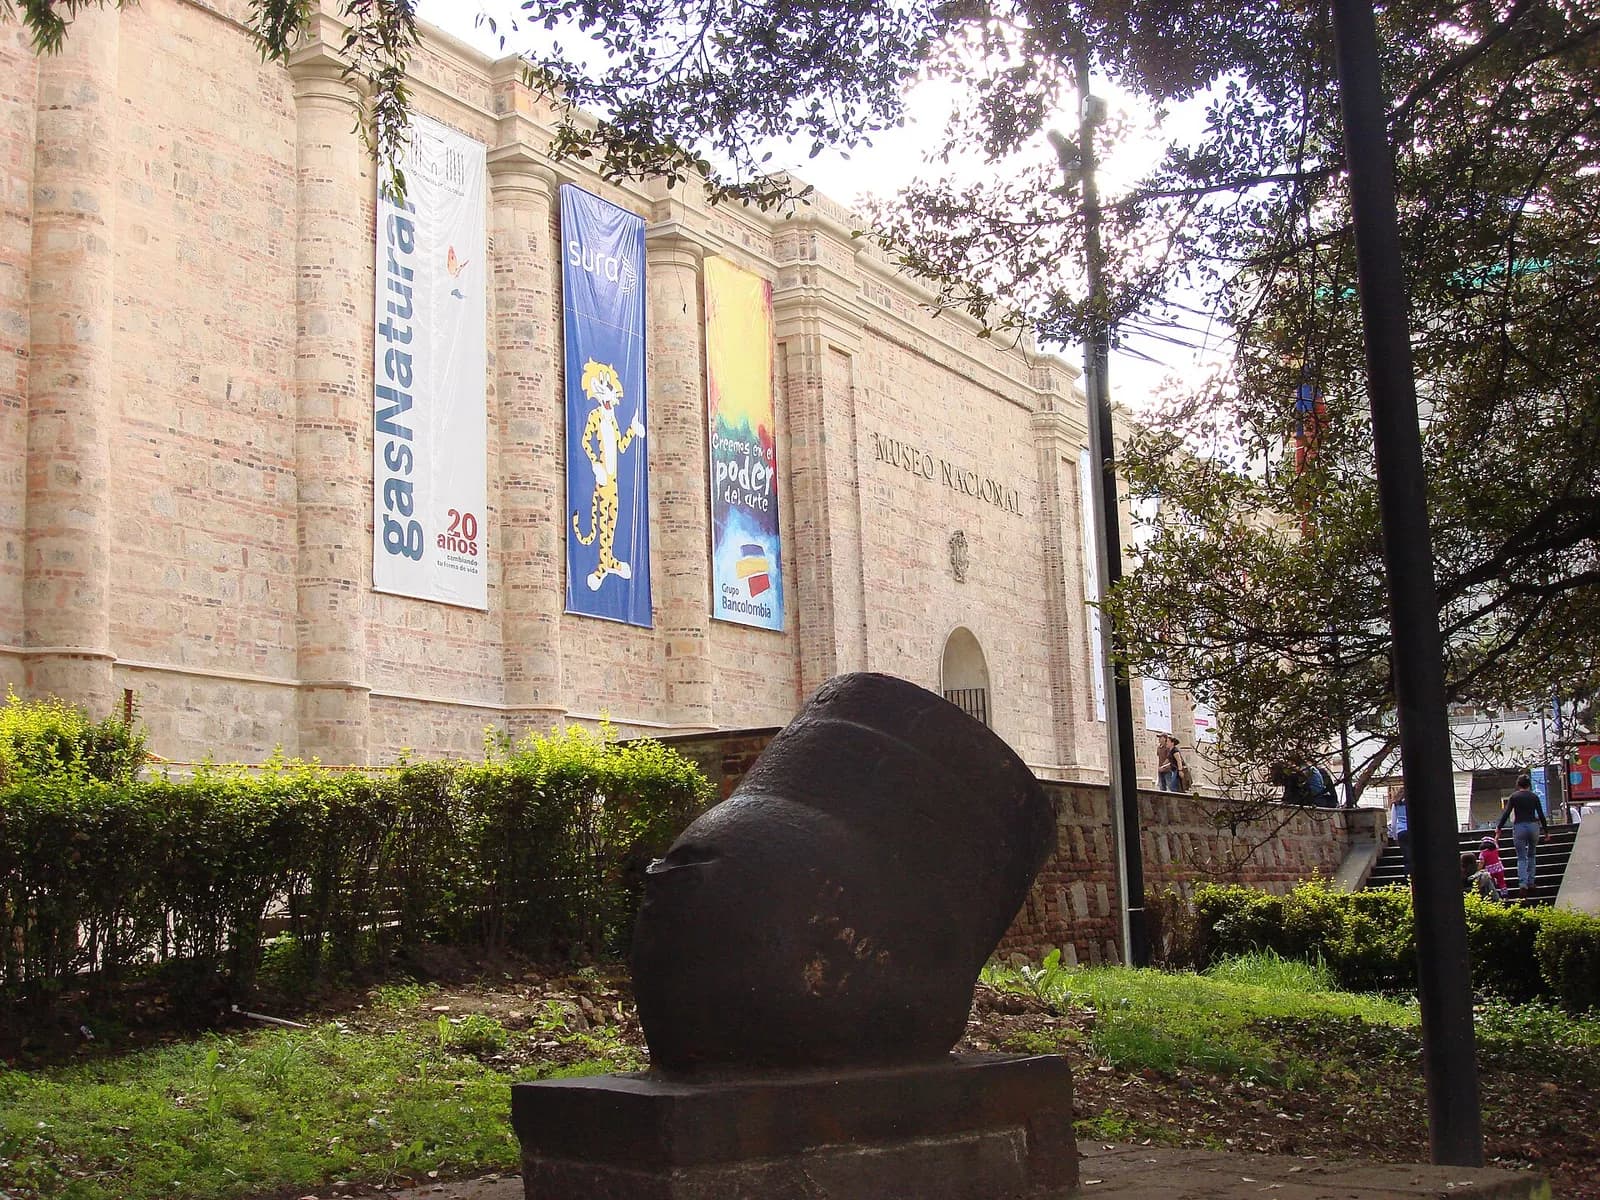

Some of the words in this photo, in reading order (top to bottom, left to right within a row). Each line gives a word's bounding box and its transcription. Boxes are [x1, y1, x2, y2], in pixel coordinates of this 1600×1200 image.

[569, 240, 619, 283] sura
[712, 432, 750, 454] Creemos
[753, 445, 763, 457] en
[766, 447, 773, 460] el
[716, 455, 774, 500] poder
[871, 432, 934, 480] MUSEO
[940, 459, 1024, 517] NACIONAL
[724, 485, 741, 505] del
[745, 493, 768, 512] arte
[447, 509, 478, 541] 20
[437, 533, 478, 556] años
[447, 555, 478, 566] cambiando
[721, 583, 740, 597] Grupo
[721, 595, 772, 618] Bancolombia
